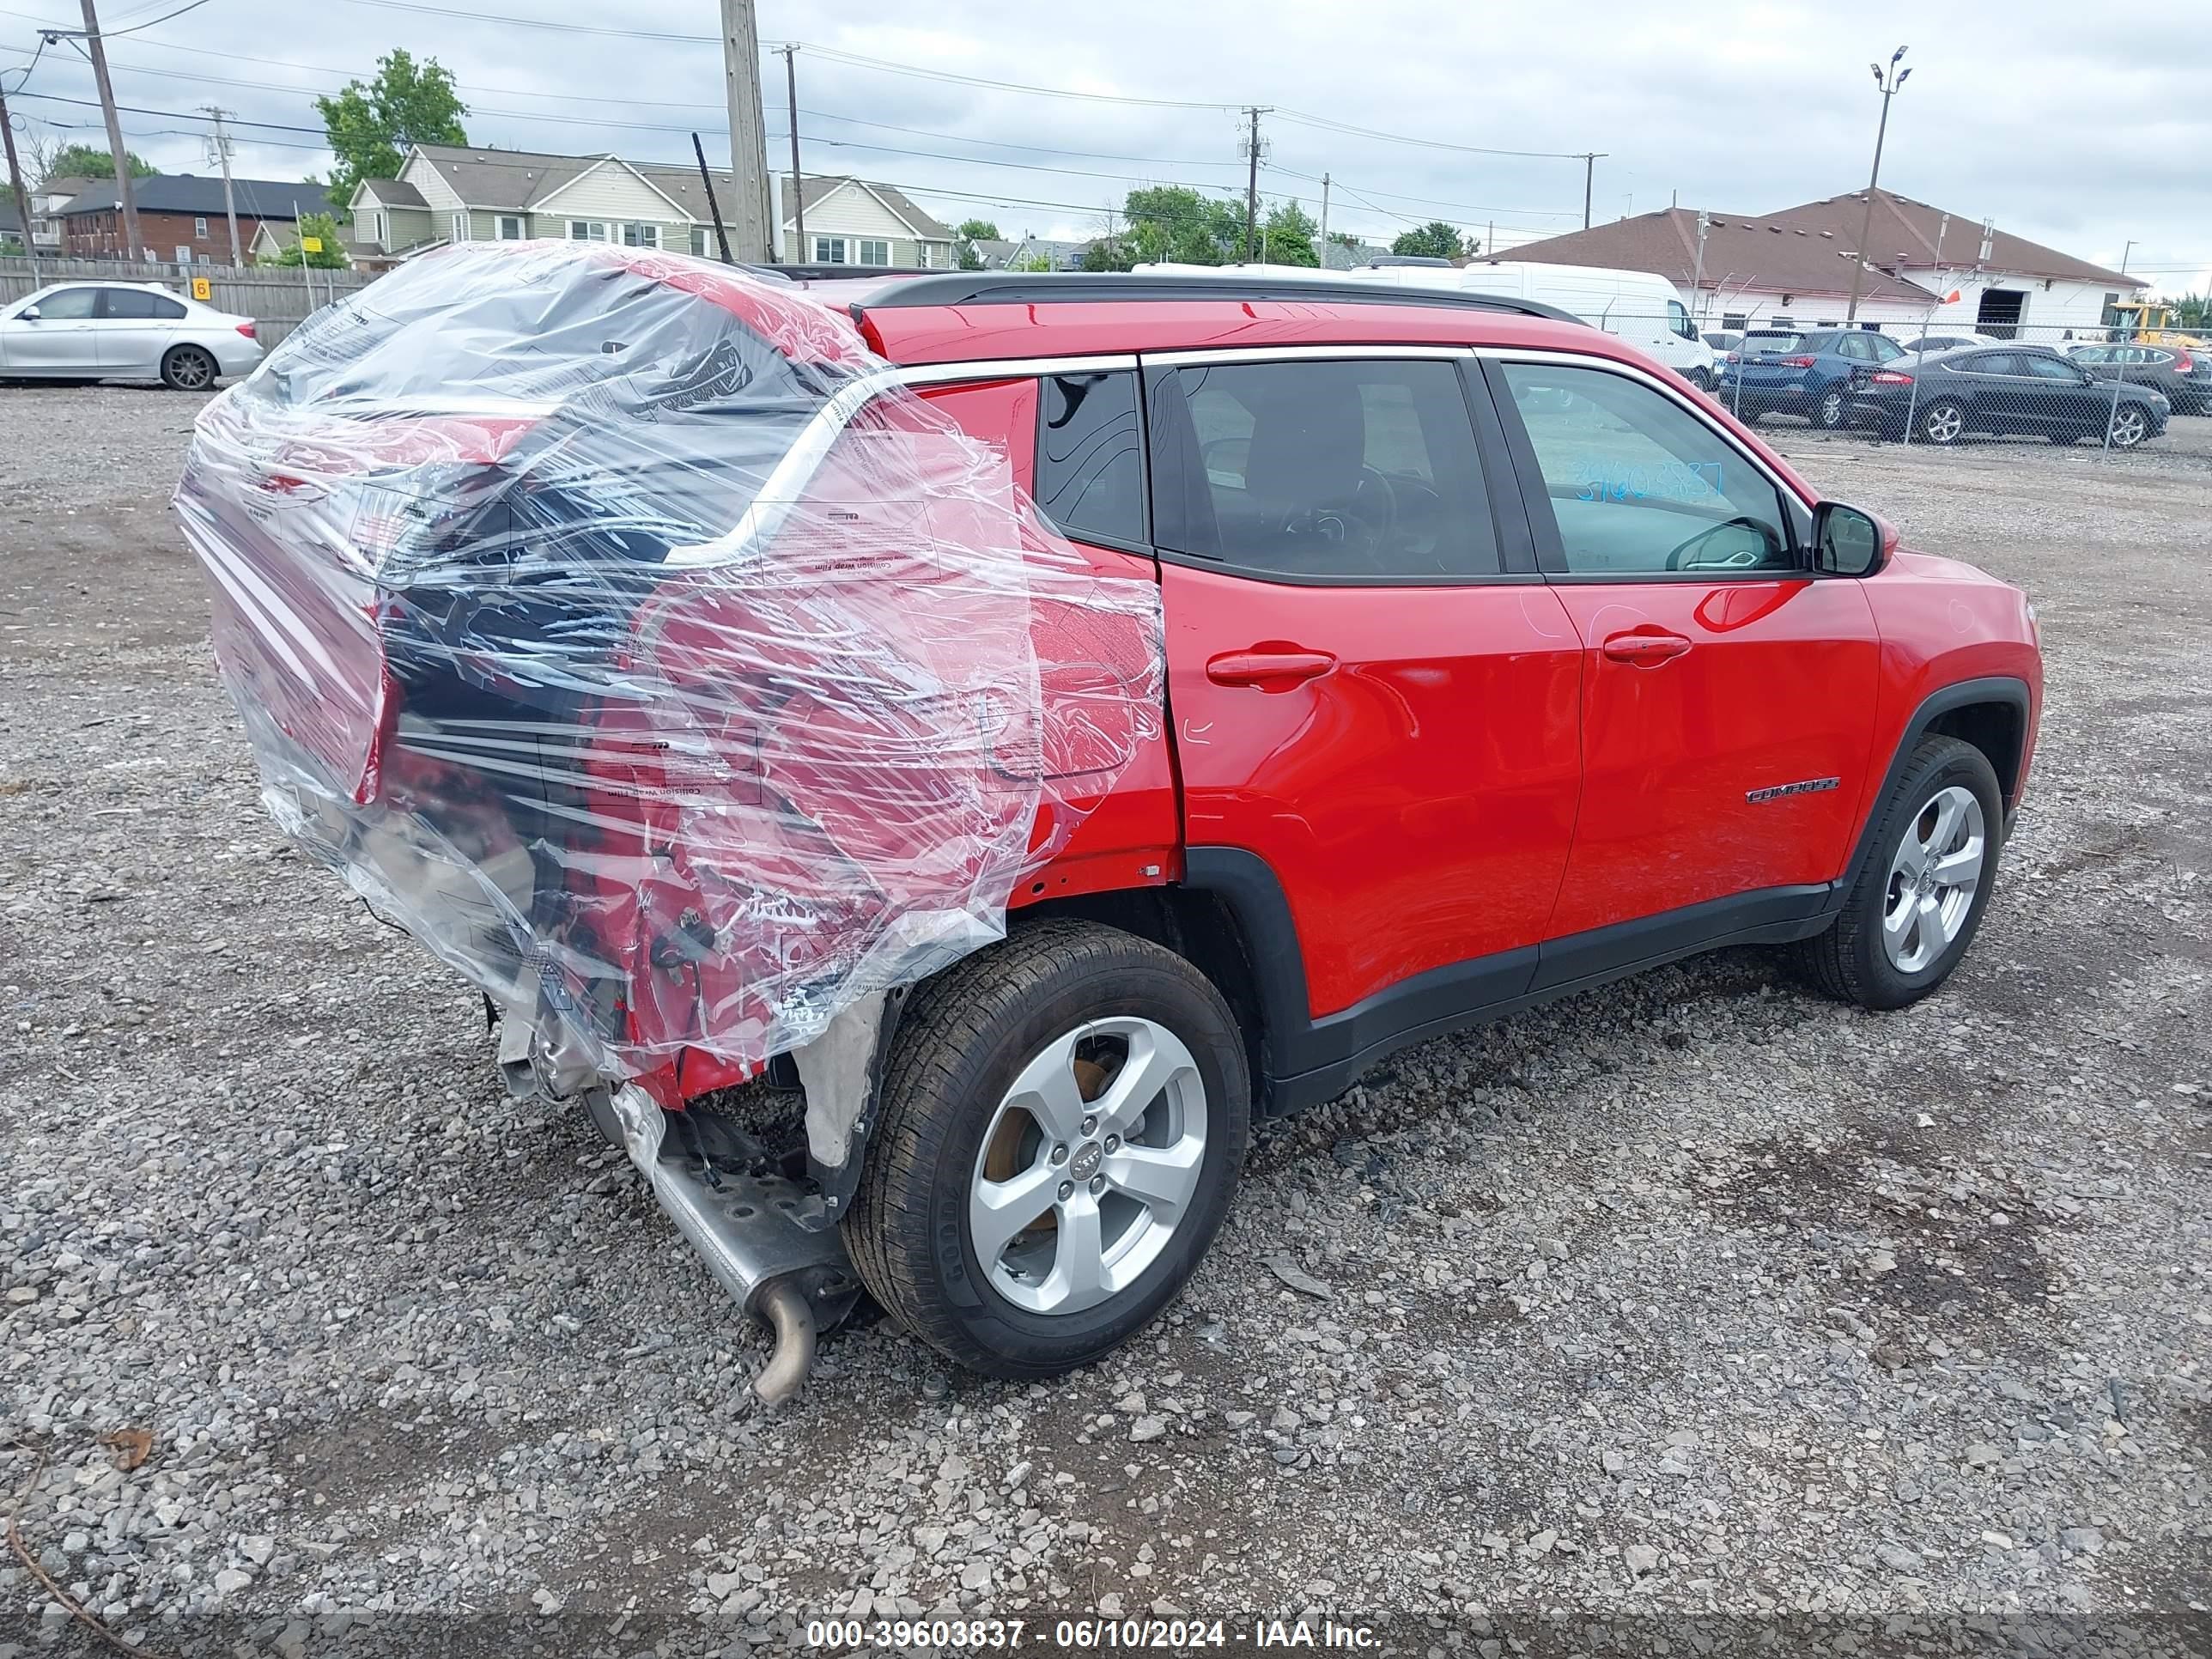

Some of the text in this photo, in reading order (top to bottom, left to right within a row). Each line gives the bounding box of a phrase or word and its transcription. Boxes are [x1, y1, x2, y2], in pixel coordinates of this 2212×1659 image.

[197, 283, 207, 295] 6
[814, 563, 833, 572] Film
[835, 562, 856, 571] Wrap
[659, 787, 701, 796] Collision
[1745, 776, 1842, 804] COMPASS
